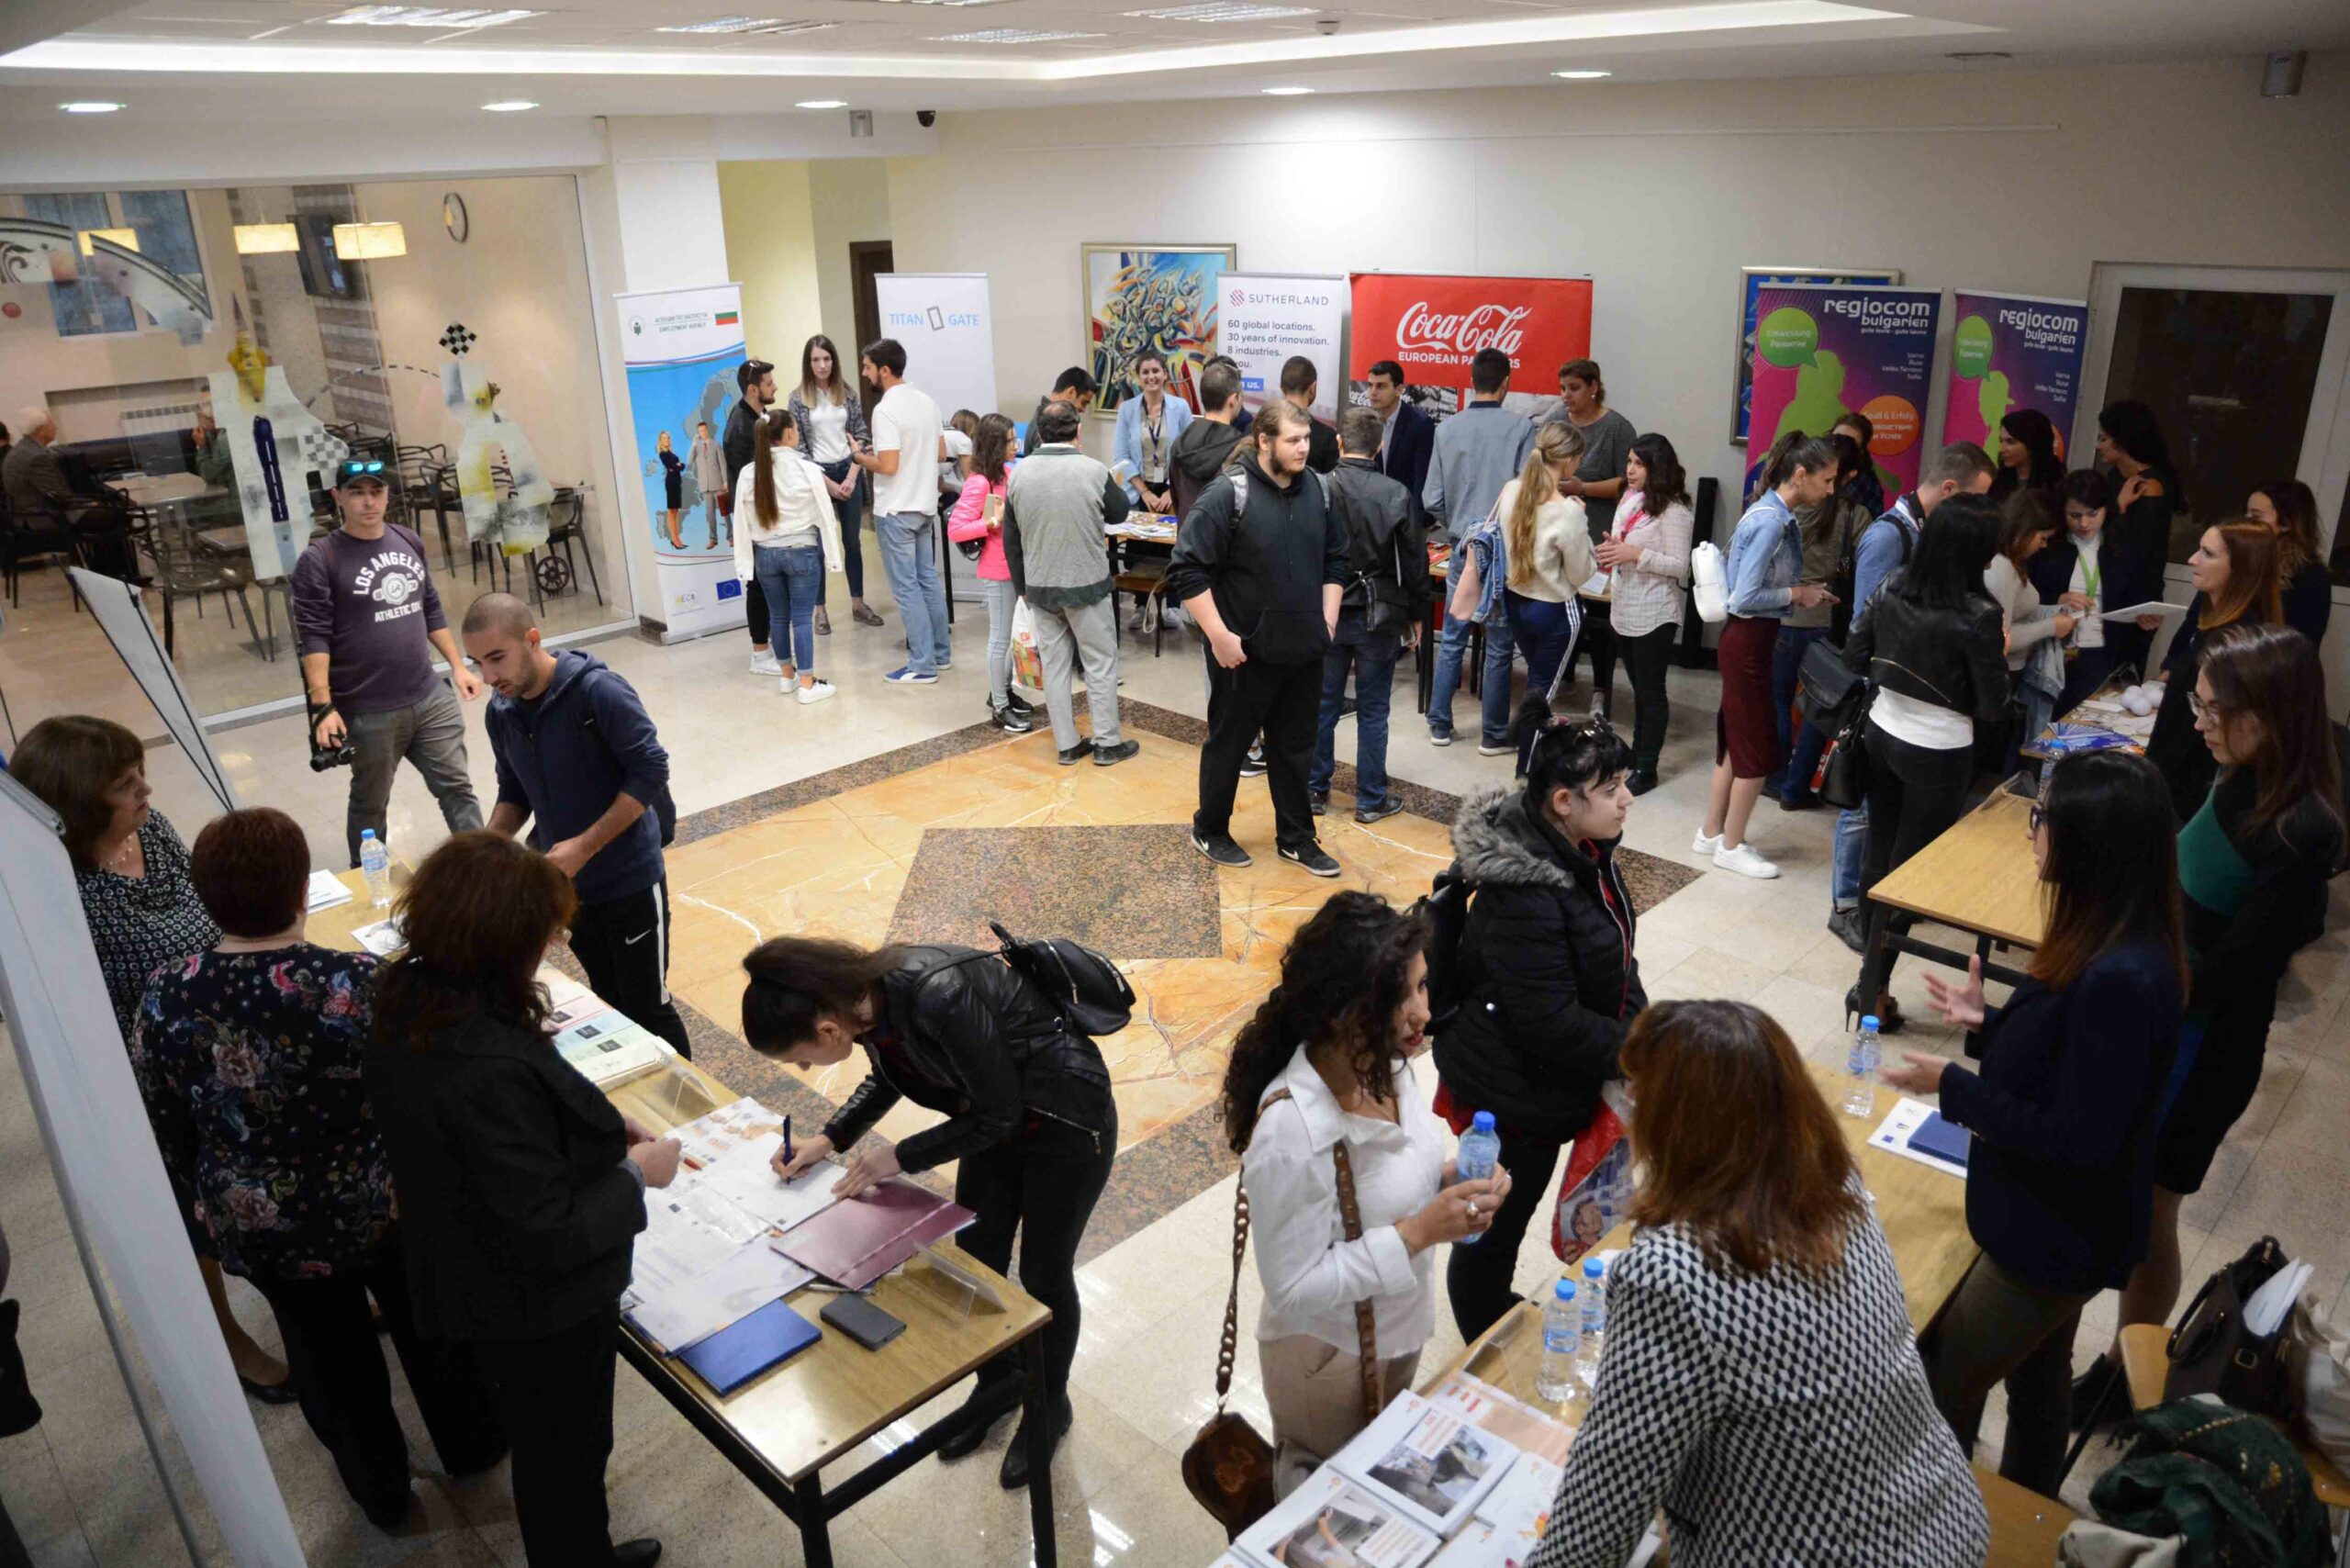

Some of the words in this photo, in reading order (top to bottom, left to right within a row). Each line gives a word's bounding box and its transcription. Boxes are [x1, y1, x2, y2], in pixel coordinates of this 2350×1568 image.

[1248, 294, 1329, 306] SUTHERLAND
[1824, 297, 1930, 318] regiocom
[890, 313, 923, 326] TITAN
[948, 314, 979, 326] GATE
[1227, 319, 1240, 329] 60
[1242, 321, 1270, 330] global
[1272, 321, 1316, 331] locations.
[1861, 315, 1929, 329] bulgarien
[1999, 308, 2078, 332] regiocom
[1396, 301, 1532, 355] Coca-Cola
[1227, 332, 1240, 342] 30
[1242, 335, 1266, 343] years
[1268, 335, 1277, 343] of
[1280, 336, 1330, 346] innovation.
[2025, 328, 2076, 345] bulgarien
[1227, 346, 1233, 354] 8
[1236, 346, 1282, 356] industries.
[1398, 352, 1459, 364] EUROPEAN
[1247, 381, 1260, 389] us.
[352, 566, 375, 595] LOS
[370, 552, 425, 581] ANGELES
[375, 604, 411, 622] ATHLETIC
